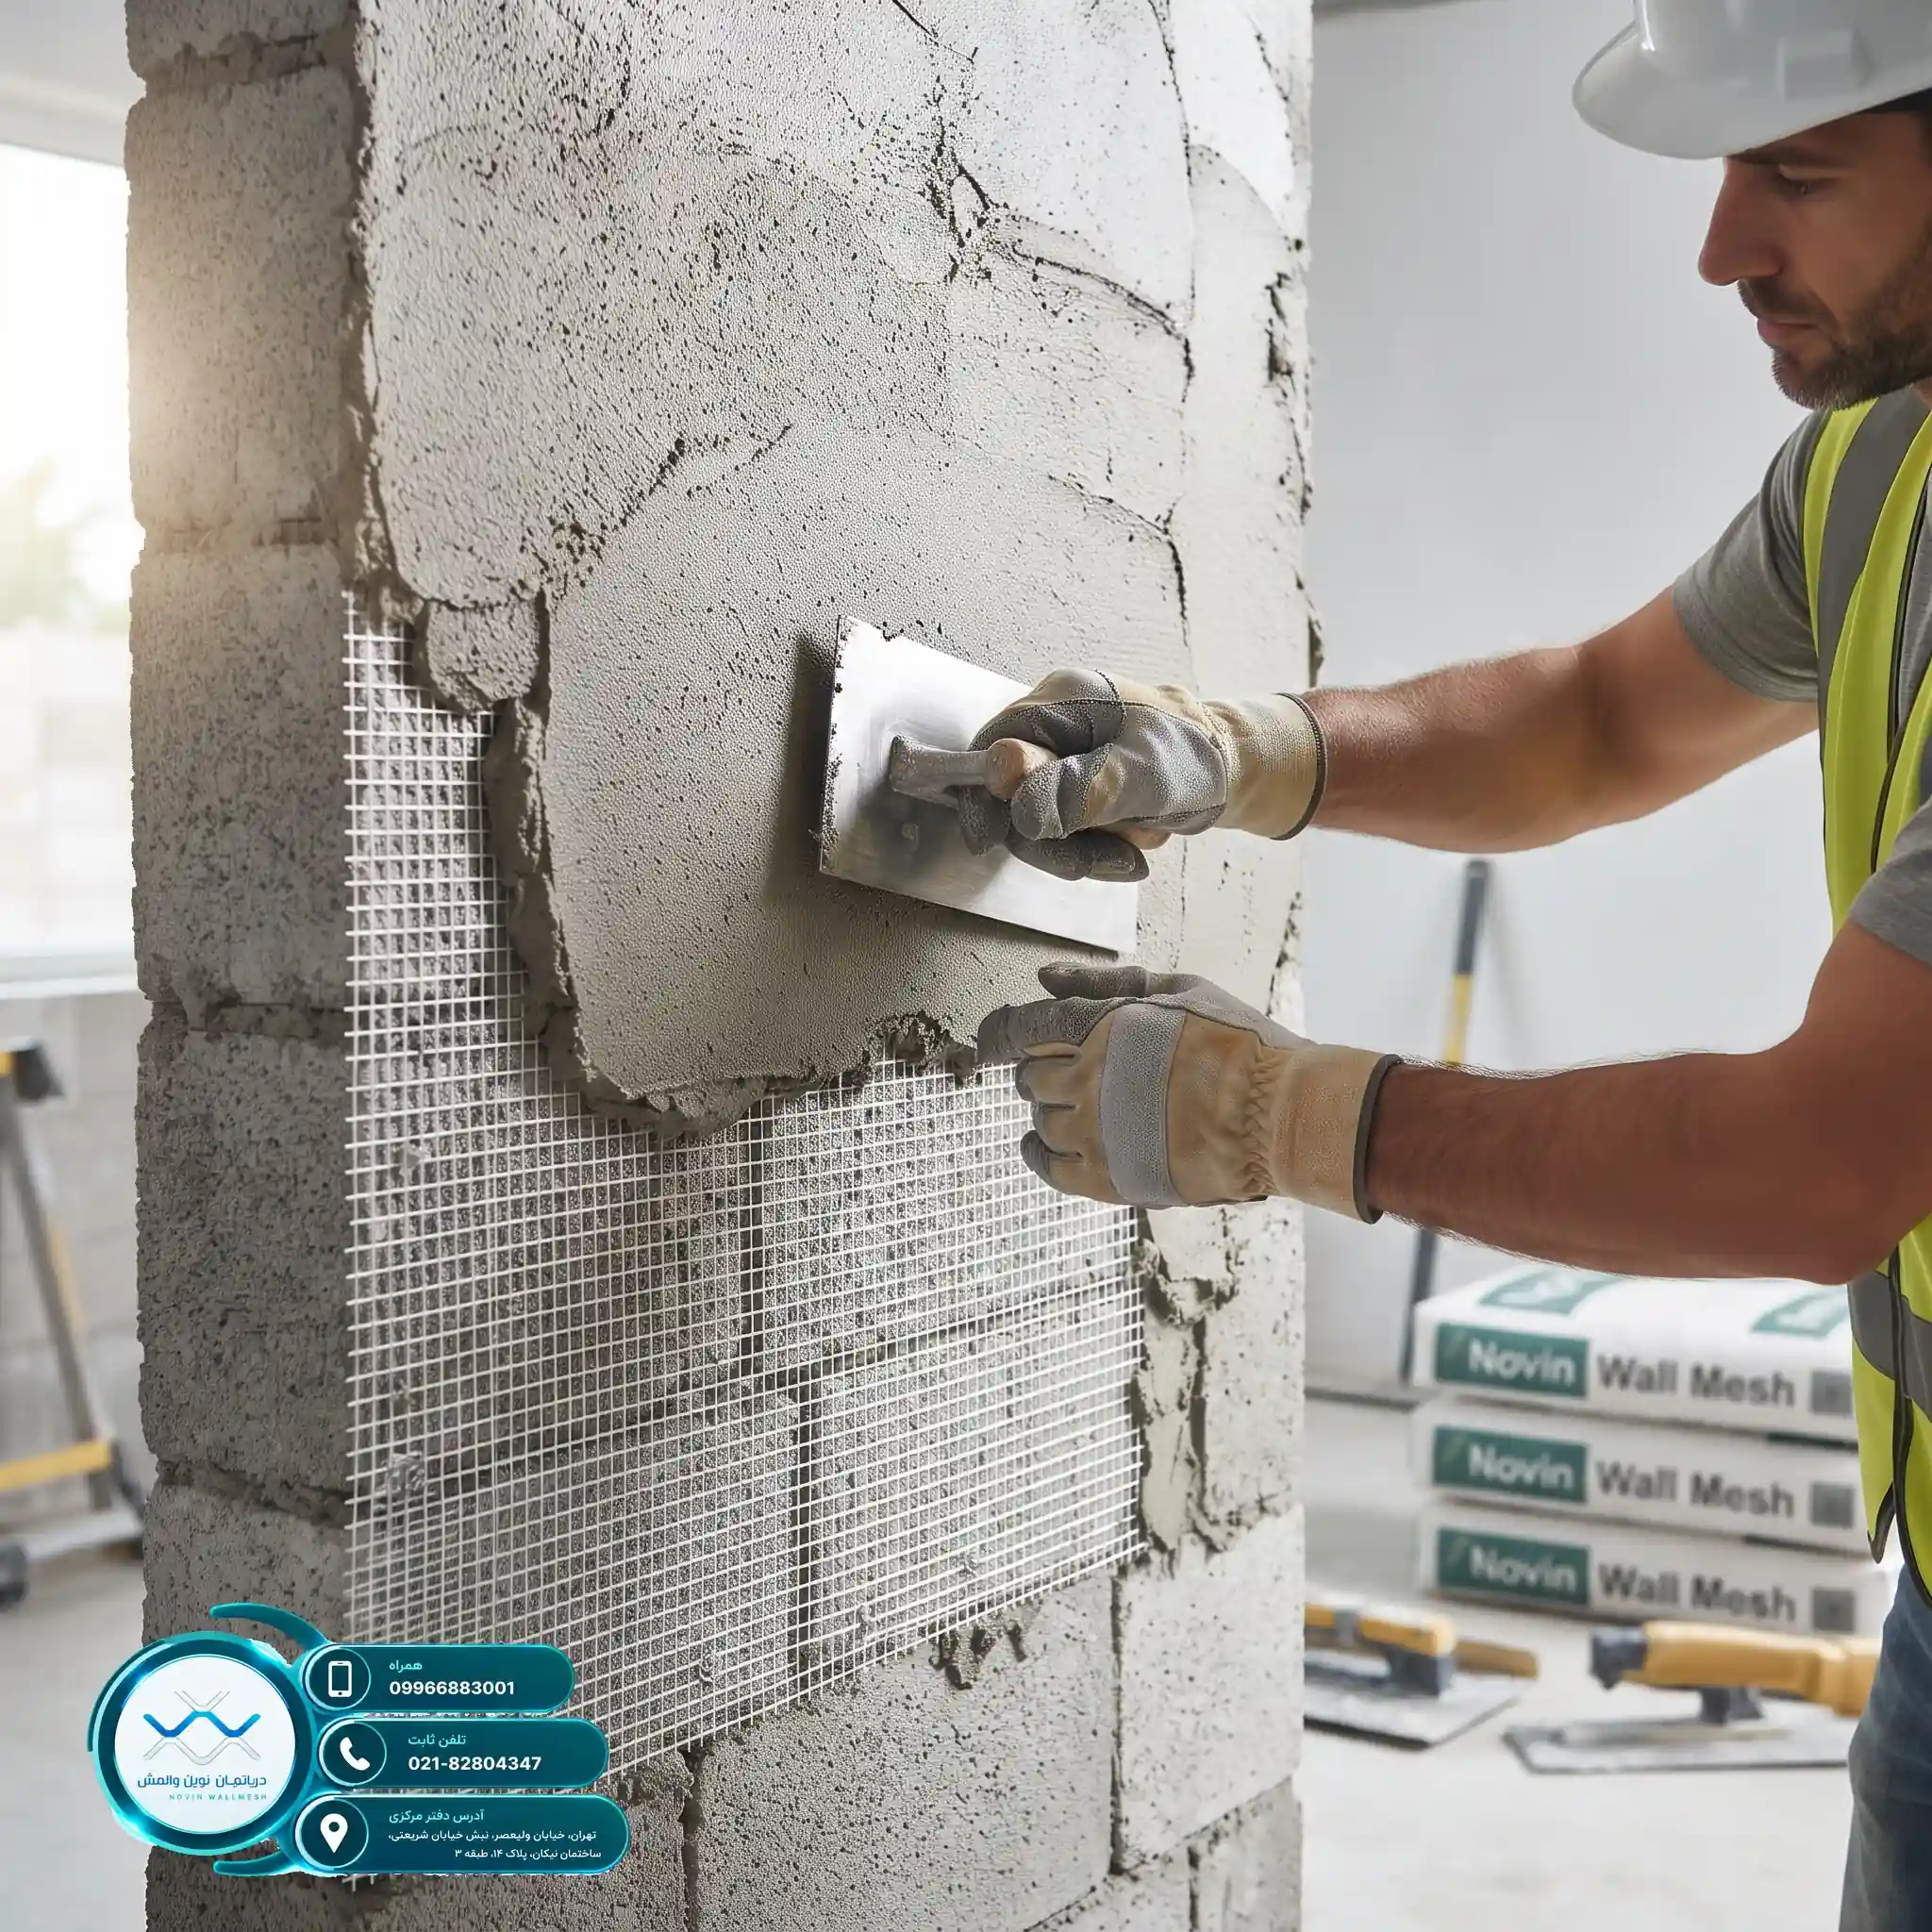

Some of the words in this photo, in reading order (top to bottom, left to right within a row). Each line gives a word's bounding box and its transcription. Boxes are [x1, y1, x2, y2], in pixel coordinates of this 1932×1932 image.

[1468, 1339, 1576, 1384] Novin
[1597, 1354, 1678, 1393] Wall
[1689, 1363, 1796, 1407] Mesh
[1468, 1444, 1575, 1489] Novin
[1596, 1460, 1677, 1501] Wall
[1689, 1474, 1796, 1518] Mesh
[1470, 1547, 1577, 1592] Novin
[1597, 1564, 1679, 1603] Wall
[1689, 1574, 1797, 1622] Mesh
